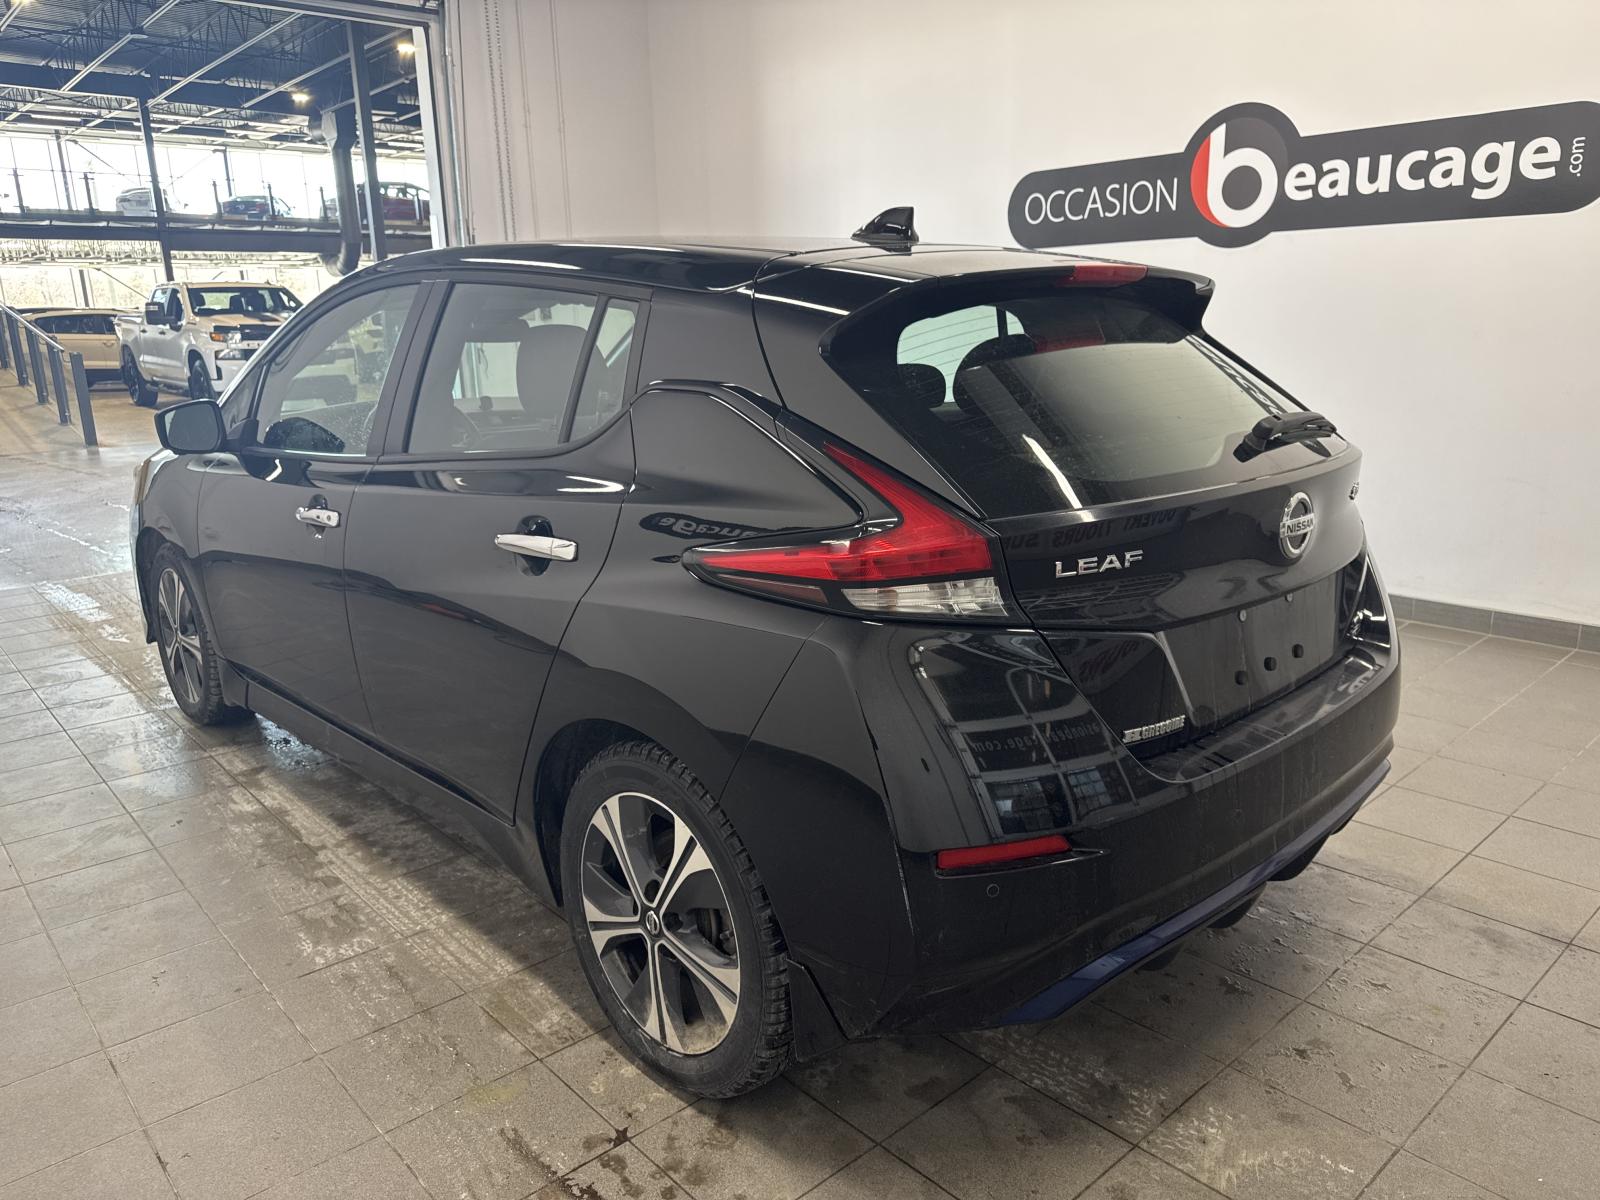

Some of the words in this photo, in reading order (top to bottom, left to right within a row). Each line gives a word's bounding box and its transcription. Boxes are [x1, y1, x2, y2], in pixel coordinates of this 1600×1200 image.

[1024, 177, 1179, 225] OCCASION
[1206, 121, 1562, 229] beaucage
[1286, 517, 1314, 535] NISSAN
[1055, 549, 1144, 579] LEAF
